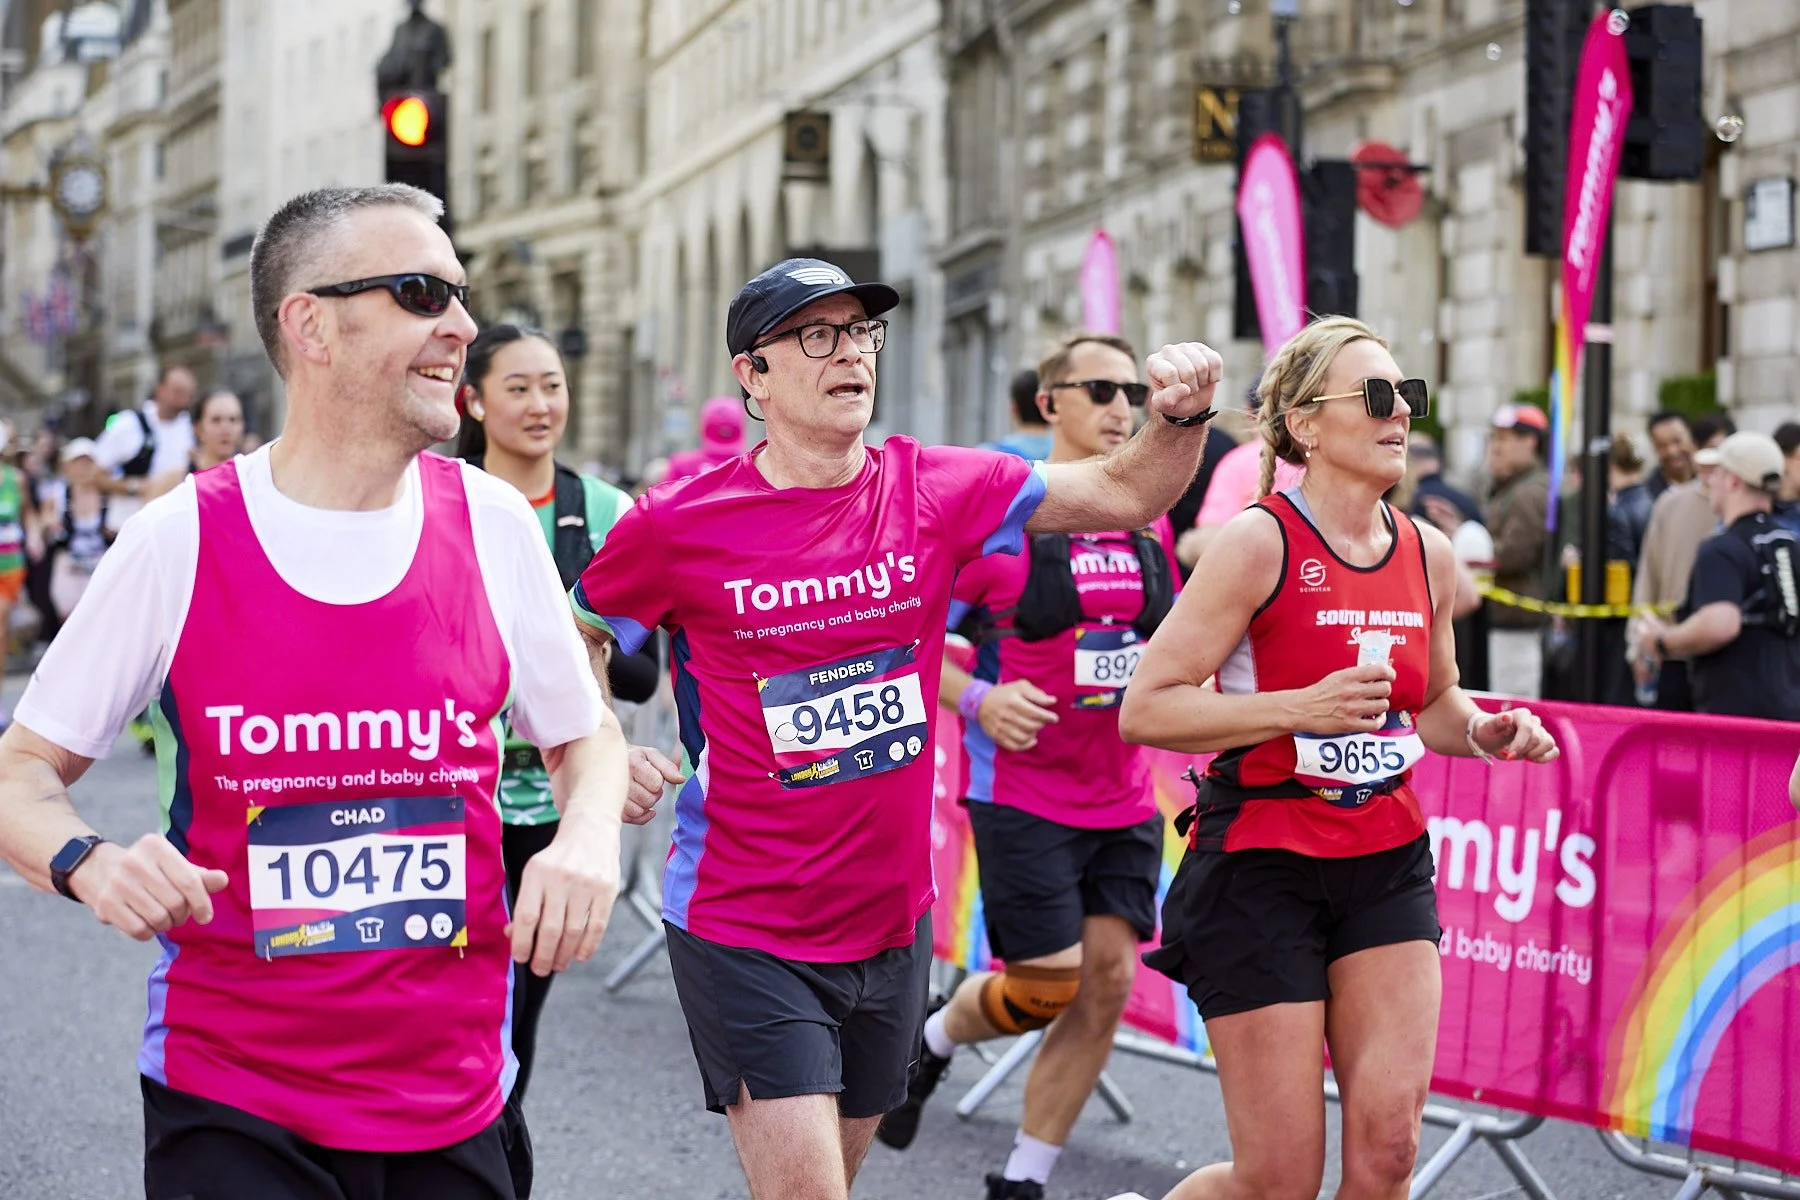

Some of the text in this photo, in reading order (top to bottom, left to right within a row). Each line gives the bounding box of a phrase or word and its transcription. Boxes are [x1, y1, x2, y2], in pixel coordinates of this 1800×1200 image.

[724, 552, 916, 615] Tommy's
[734, 595, 921, 640] The pregnancy and baby charity
[1316, 609, 1424, 628] SOUTH MOLTON
[809, 660, 875, 686] FENDERS
[205, 698, 478, 761] Tommy's
[792, 684, 905, 745] 9458
[214, 766, 479, 793] The pregnancy and baby charity
[1318, 740, 1405, 774] 9655
[330, 807, 386, 826] CHAD
[267, 843, 451, 900] 10475
[1456, 928, 1512, 972] baby
[1516, 939, 1592, 985] charity
